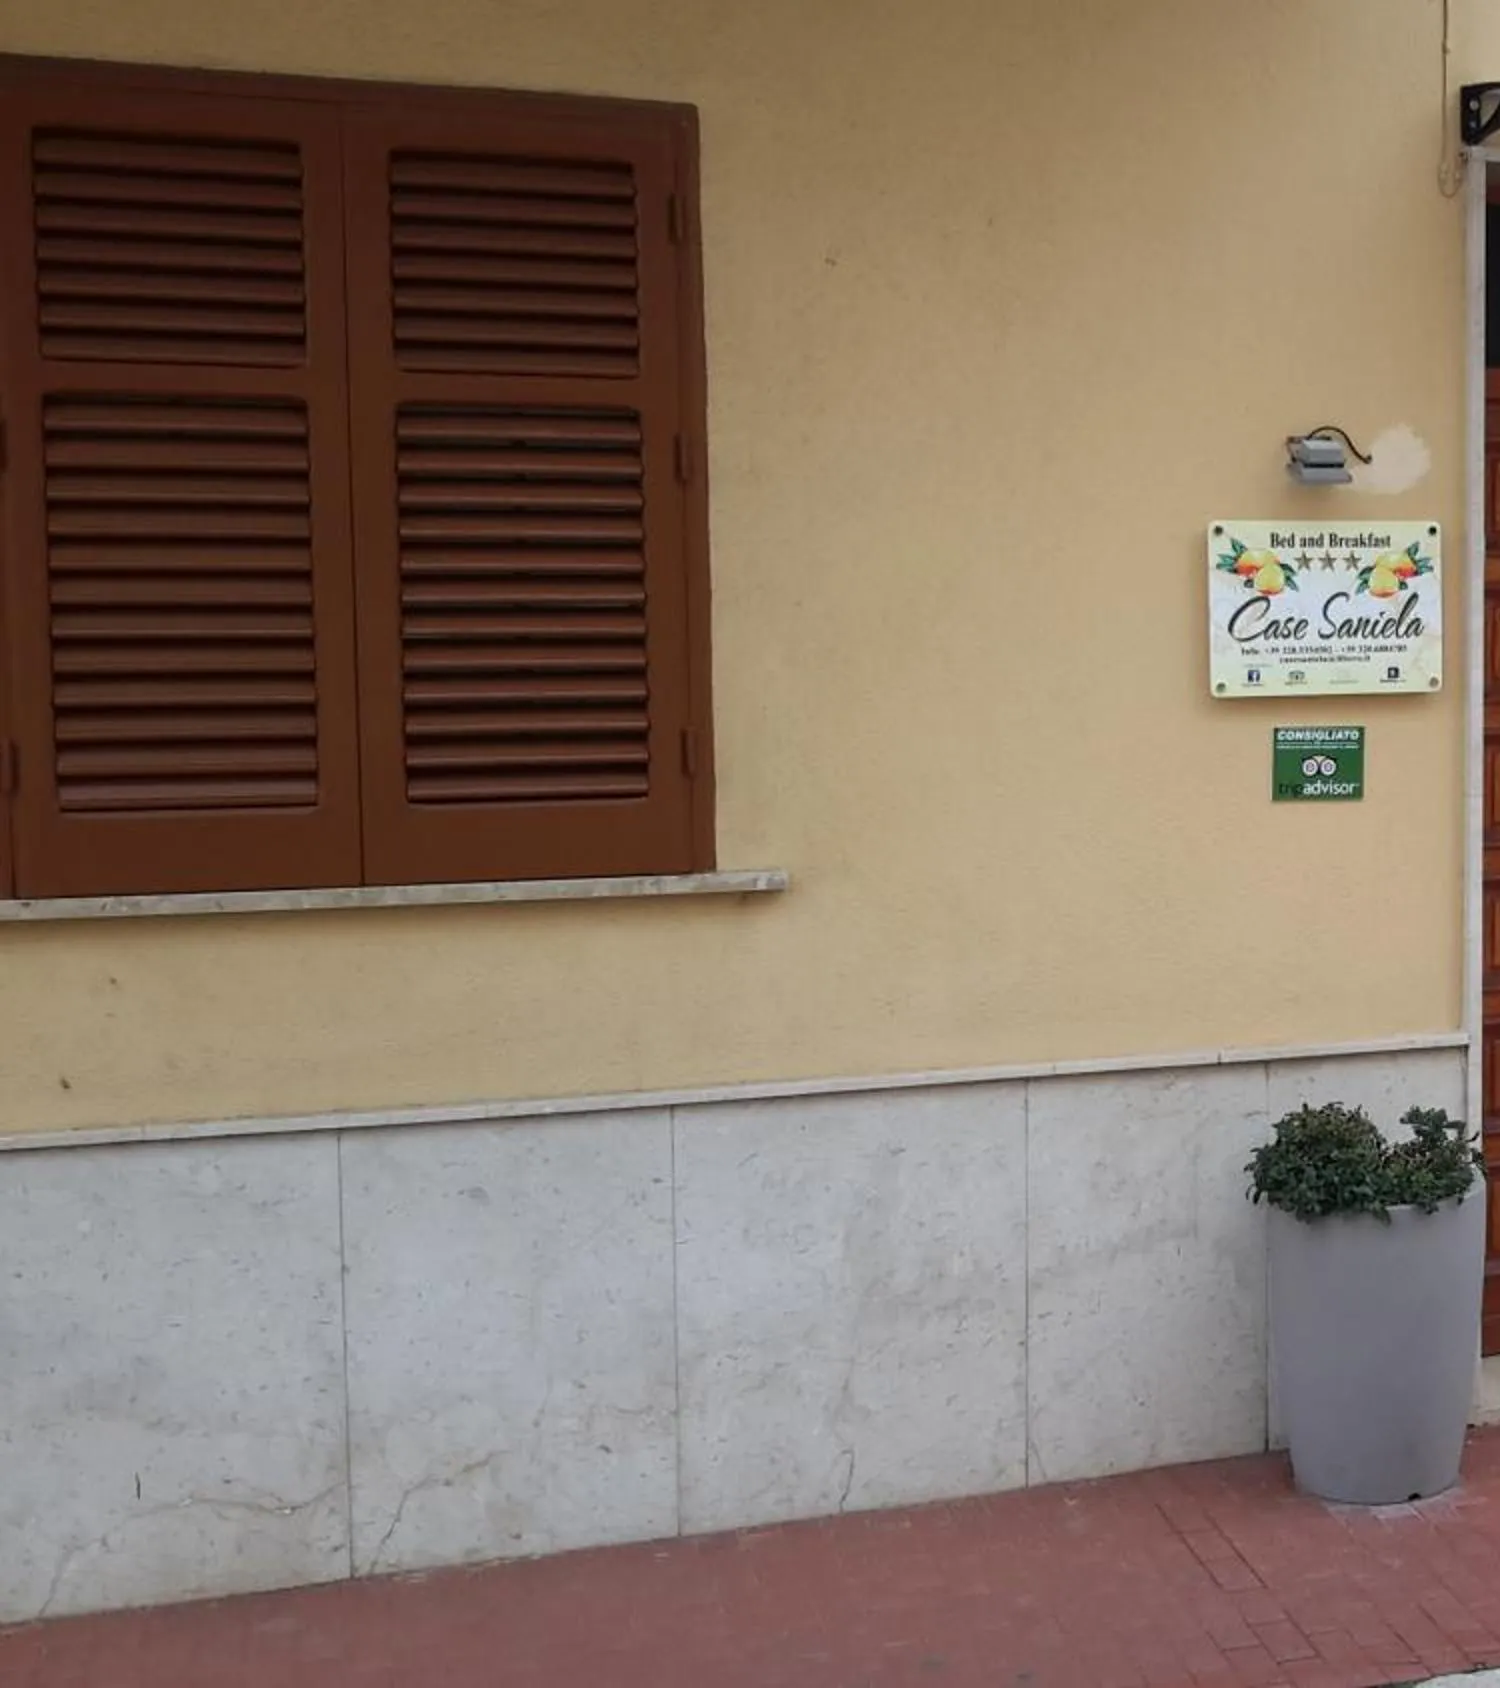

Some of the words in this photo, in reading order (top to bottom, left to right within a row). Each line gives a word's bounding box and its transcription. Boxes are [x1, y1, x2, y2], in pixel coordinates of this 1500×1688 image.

[1270, 532, 1295, 549] Bed
[1299, 533, 1324, 548] and
[1329, 532, 1391, 548] Breakfast
[1227, 595, 1309, 642] Case
[1318, 591, 1425, 640] Saniela
[1277, 730, 1360, 741] CONSIGLIATO
